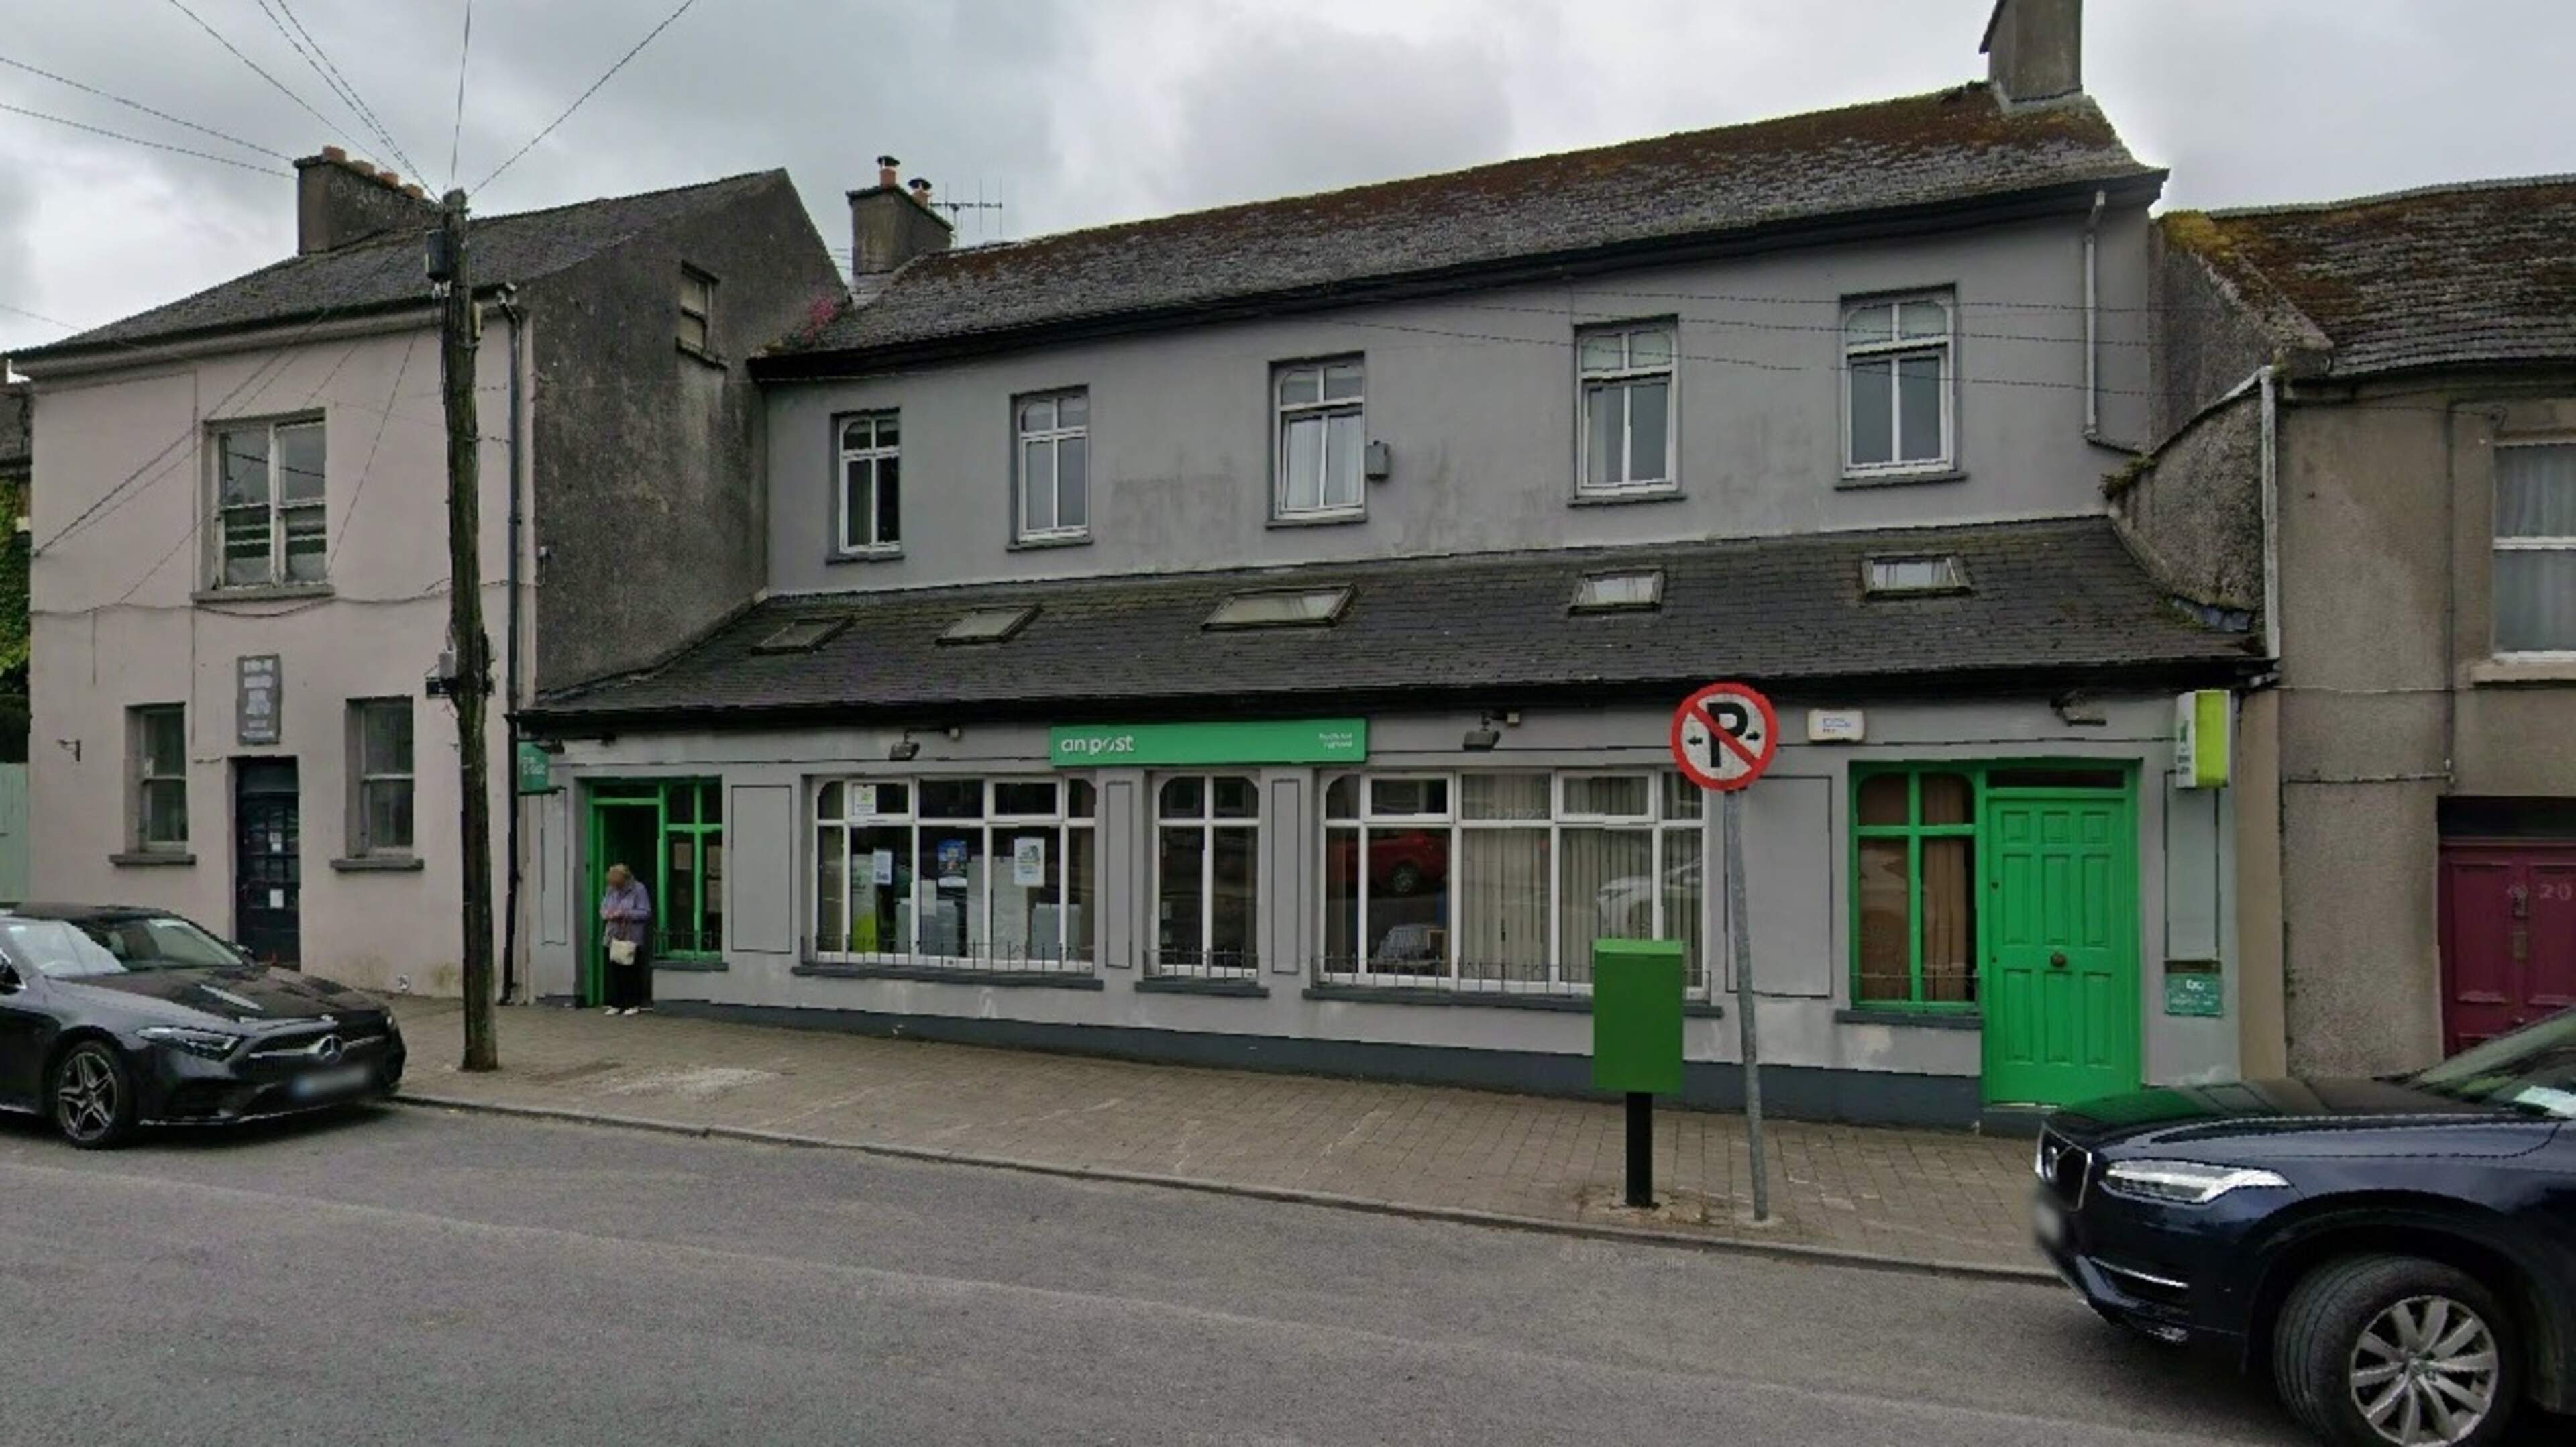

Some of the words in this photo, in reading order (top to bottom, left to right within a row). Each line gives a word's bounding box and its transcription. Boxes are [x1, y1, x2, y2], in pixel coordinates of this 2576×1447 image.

[1061, 738, 1086, 752] an
[1089, 735, 1134, 755] post
[1707, 702, 1748, 768] P
[2538, 883, 2573, 901] 20
